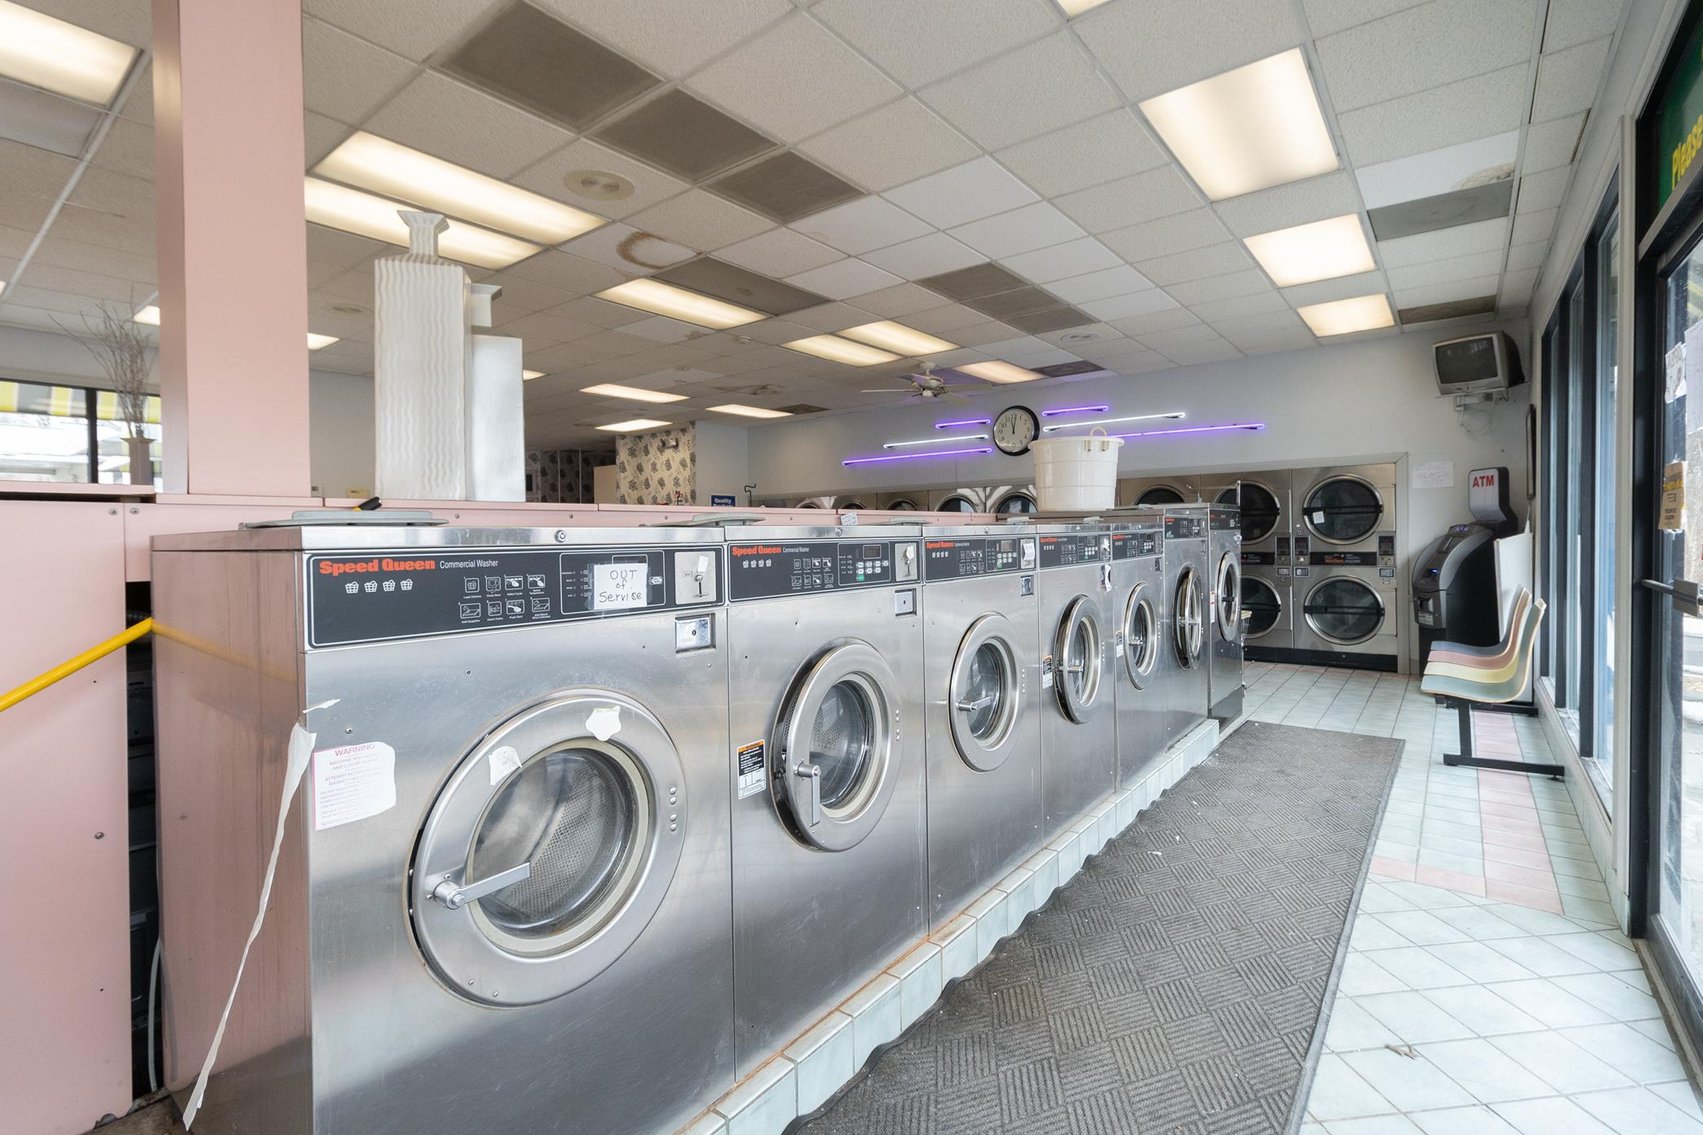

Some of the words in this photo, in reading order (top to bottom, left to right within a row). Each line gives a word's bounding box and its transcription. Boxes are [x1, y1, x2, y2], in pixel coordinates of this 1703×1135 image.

[1472, 474, 1495, 488] ATM
[732, 546, 757, 557] Speed
[758, 545, 781, 554] Queen
[319, 559, 379, 575] Speed
[382, 558, 436, 572] Queen
[439, 560, 475, 570] Commercial
[476, 559, 499, 568] Washer
[609, 569, 638, 580] OUT
[615, 579, 627, 589] of
[334, 743, 376, 756] WARNING
